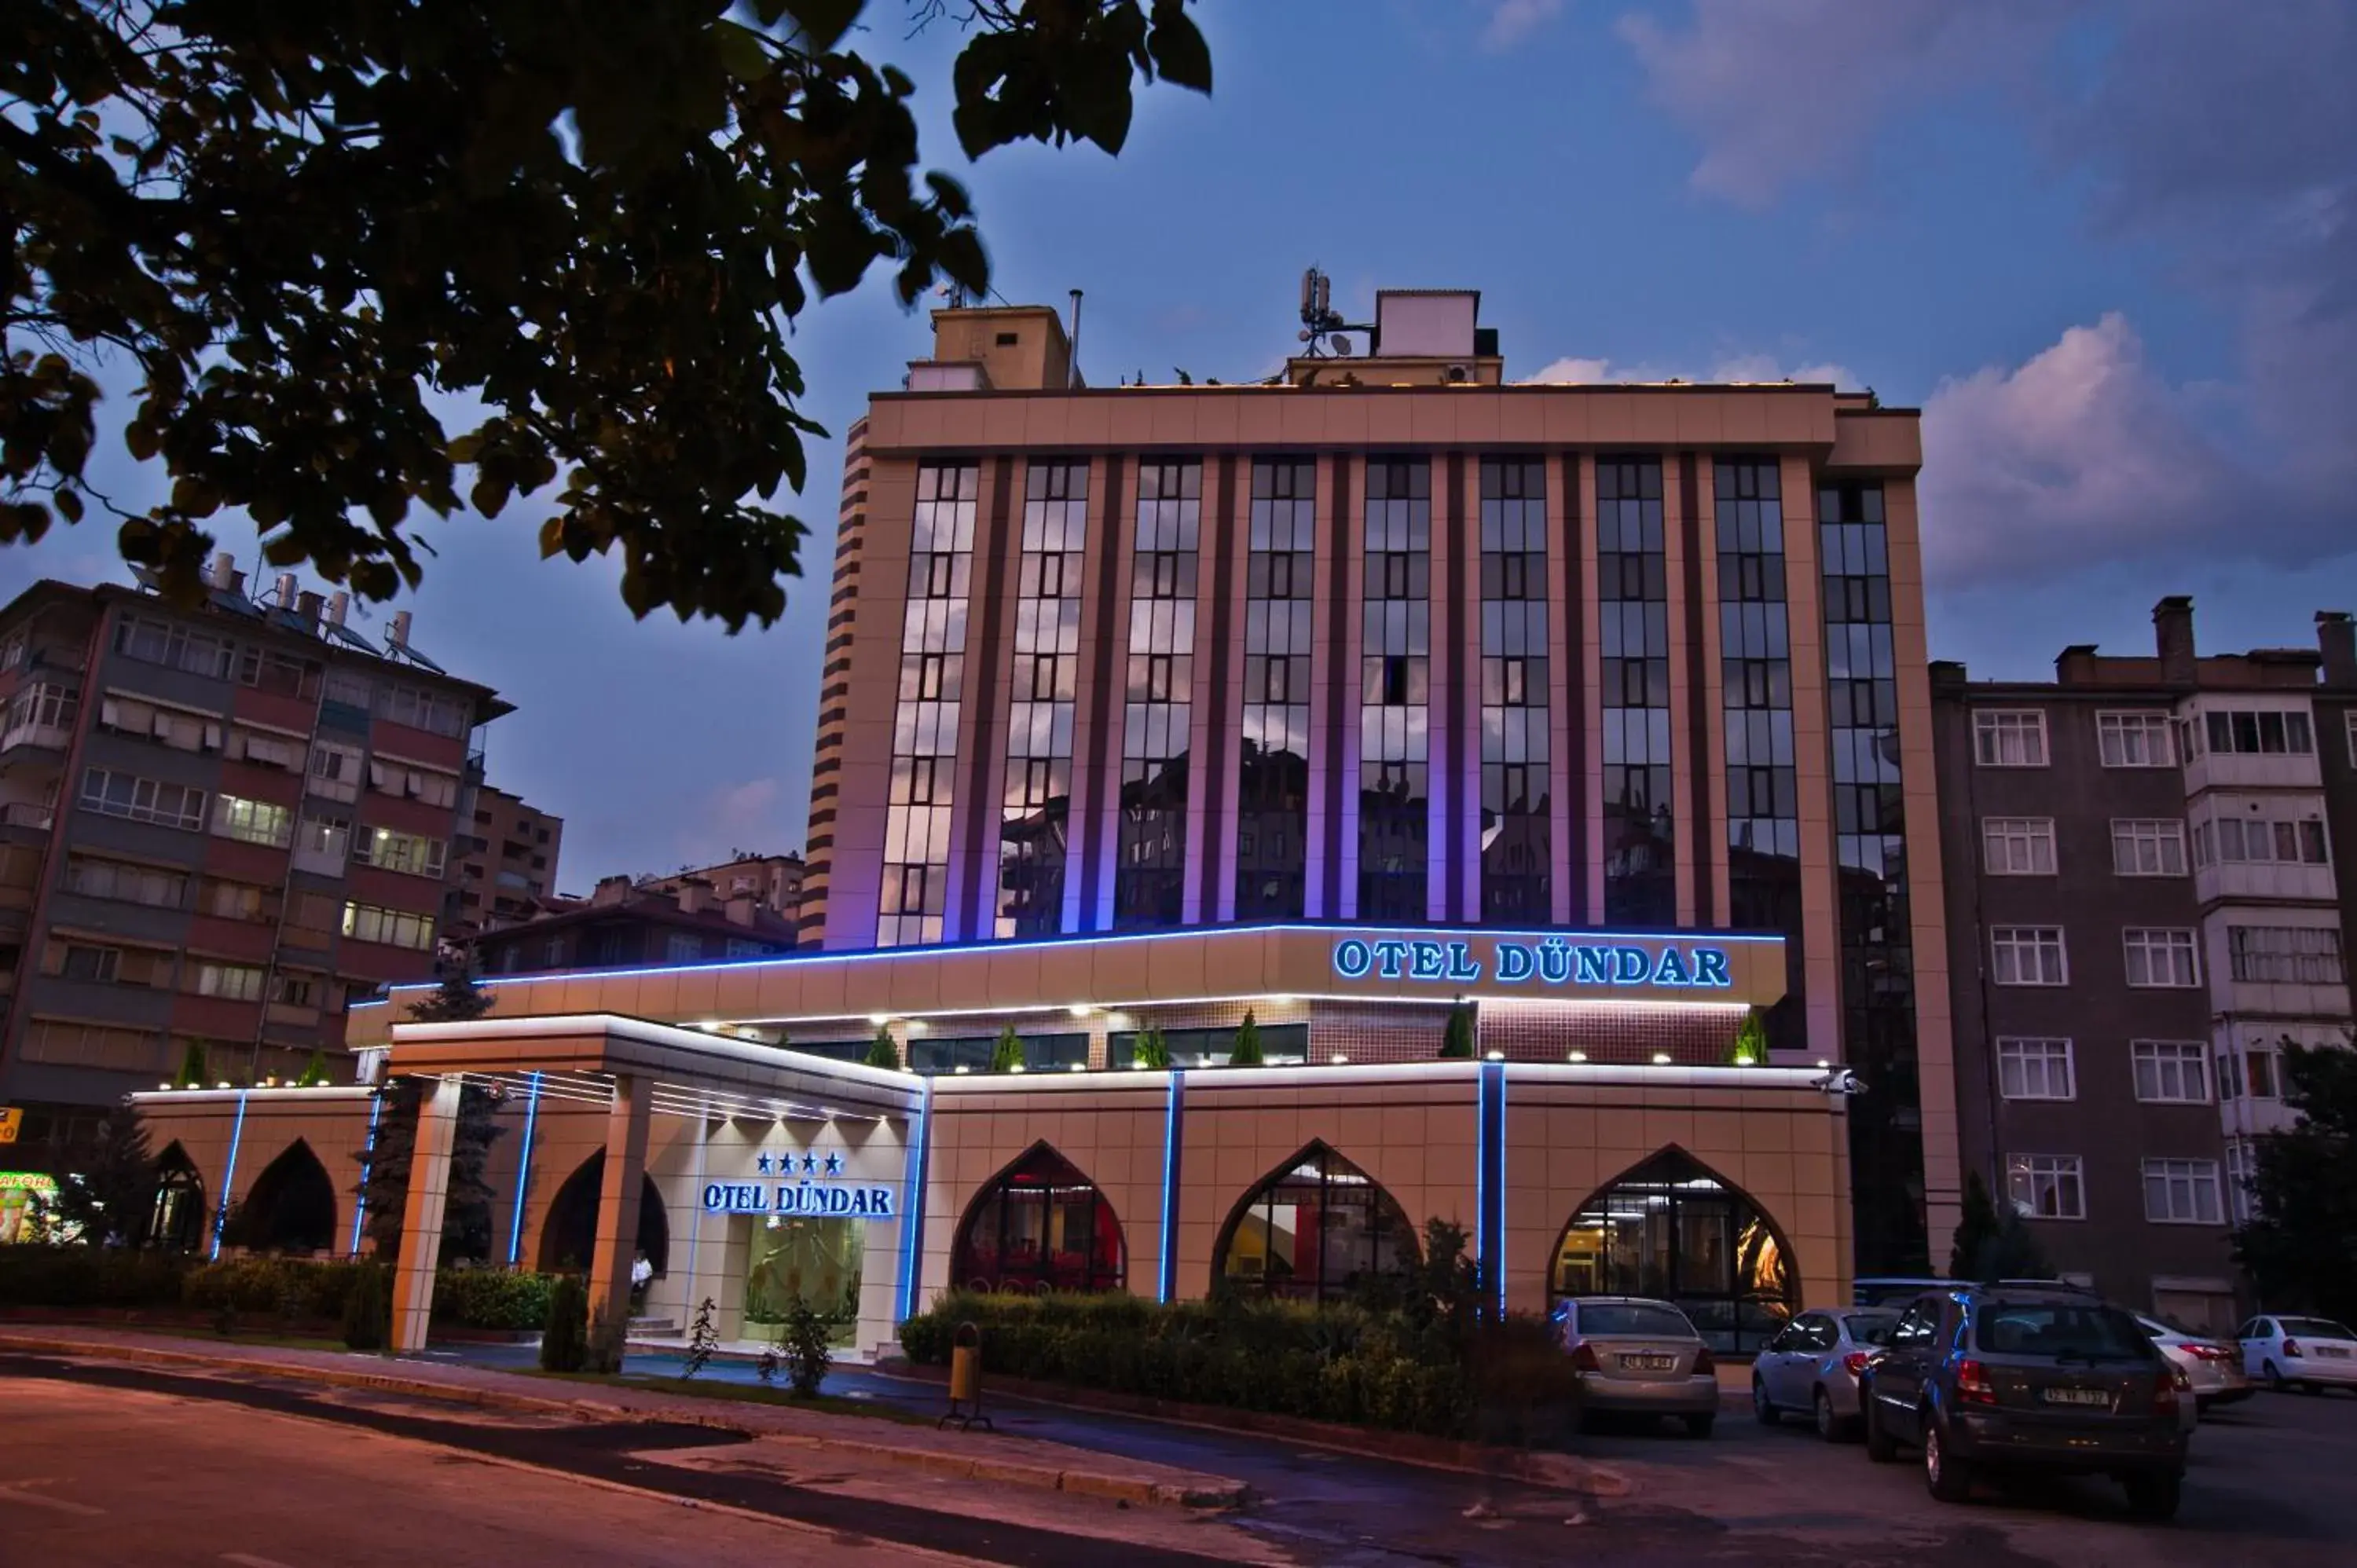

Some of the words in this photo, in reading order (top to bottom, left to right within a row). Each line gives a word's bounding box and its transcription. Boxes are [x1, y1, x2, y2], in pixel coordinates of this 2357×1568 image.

[1335, 940, 1480, 979] OTEL
[1496, 938, 1731, 986] DÜNDAR
[703, 1184, 768, 1210] OTEL
[776, 1180, 892, 1214] DÜNDAR
